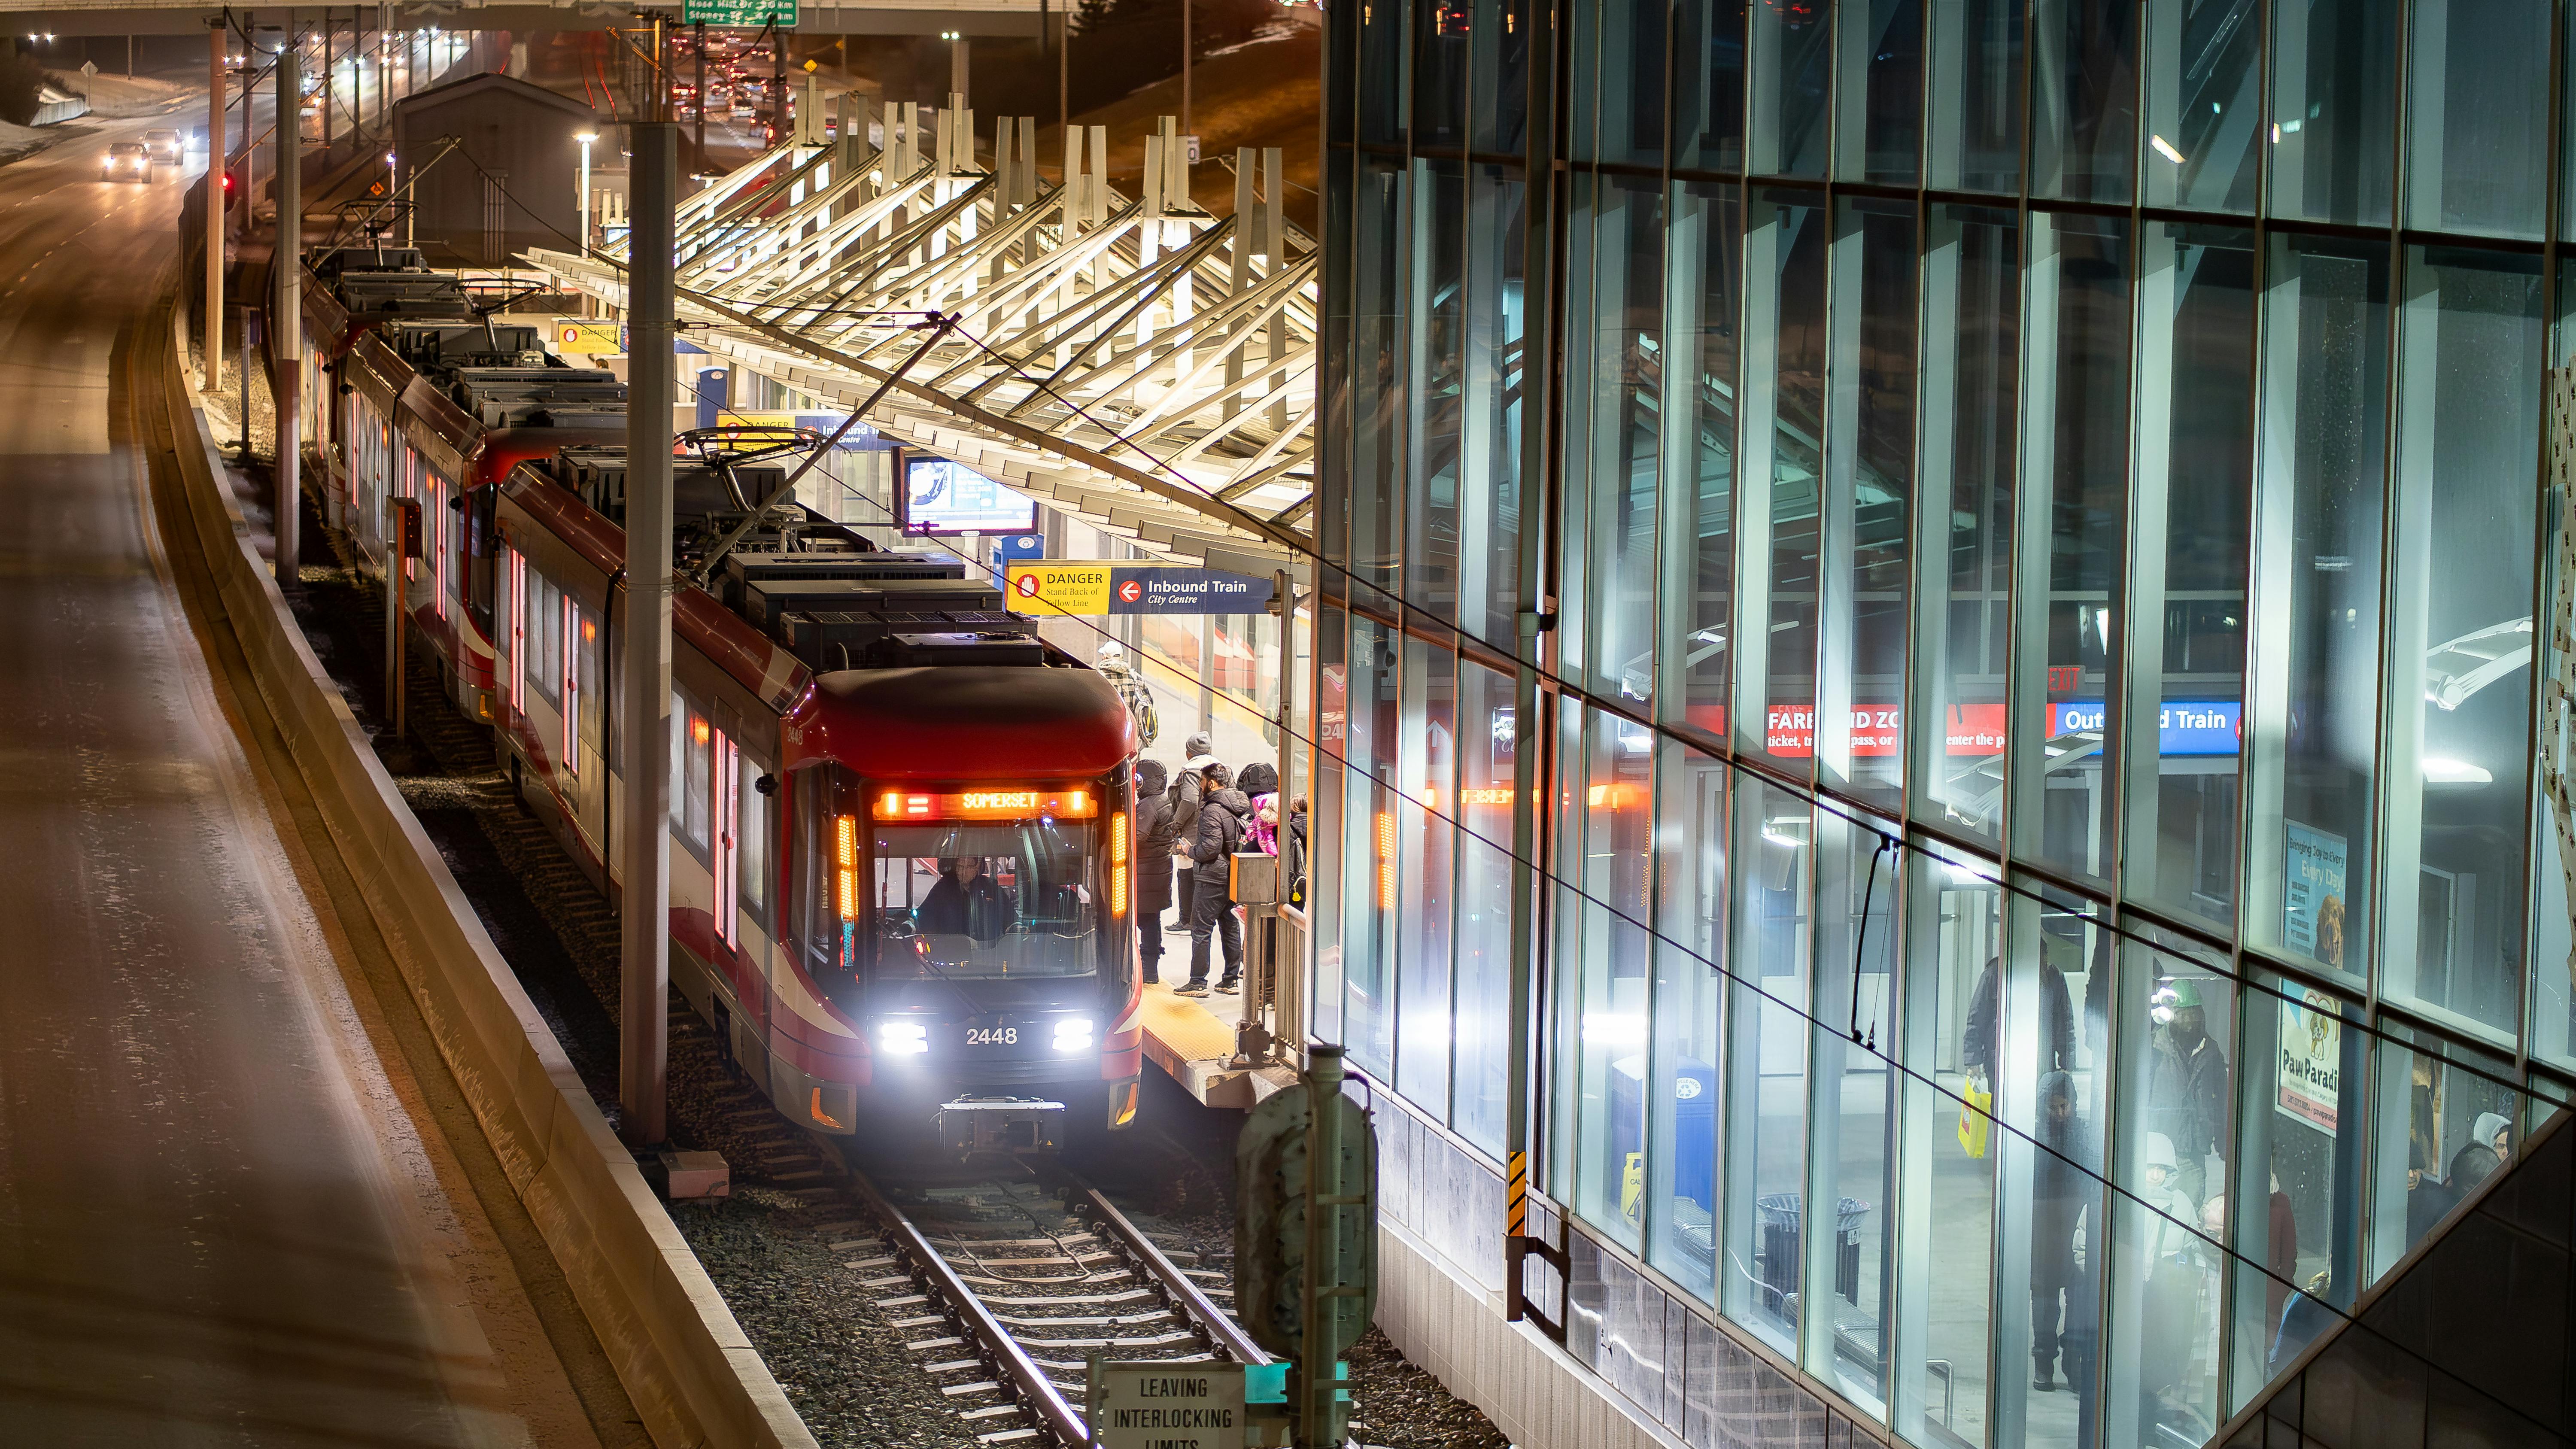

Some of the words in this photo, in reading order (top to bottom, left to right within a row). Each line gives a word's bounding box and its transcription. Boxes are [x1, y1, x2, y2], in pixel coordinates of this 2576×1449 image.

[823, 425, 868, 435] Inbund
[1047, 574, 1103, 584] DANGER
[1148, 580, 1208, 592] Inbound
[1212, 580, 1247, 592] Train
[1091, 587, 1099, 595] of
[1148, 595, 1166, 606] City
[1168, 595, 1198, 604] Centre
[2048, 668, 2080, 691] EXIT
[2175, 709, 2226, 729] Train
[787, 726, 803, 745] 2448
[1768, 734, 1801, 749] ticket,
[1851, 735, 1877, 748] pass,
[1878, 736, 1894, 746] or
[1946, 735, 1975, 746] enter
[1975, 732, 1994, 746] the
[963, 792, 1038, 808] SOMERSET
[2302, 859, 2324, 887] Every
[966, 1027, 1018, 1045] 2448
[2283, 1048, 2303, 1078] Paw
[2305, 1057, 2337, 1093] Paradi
[1140, 1378, 1207, 1397] LEAVING
[1114, 1408, 1232, 1428] INTERLOCKING
